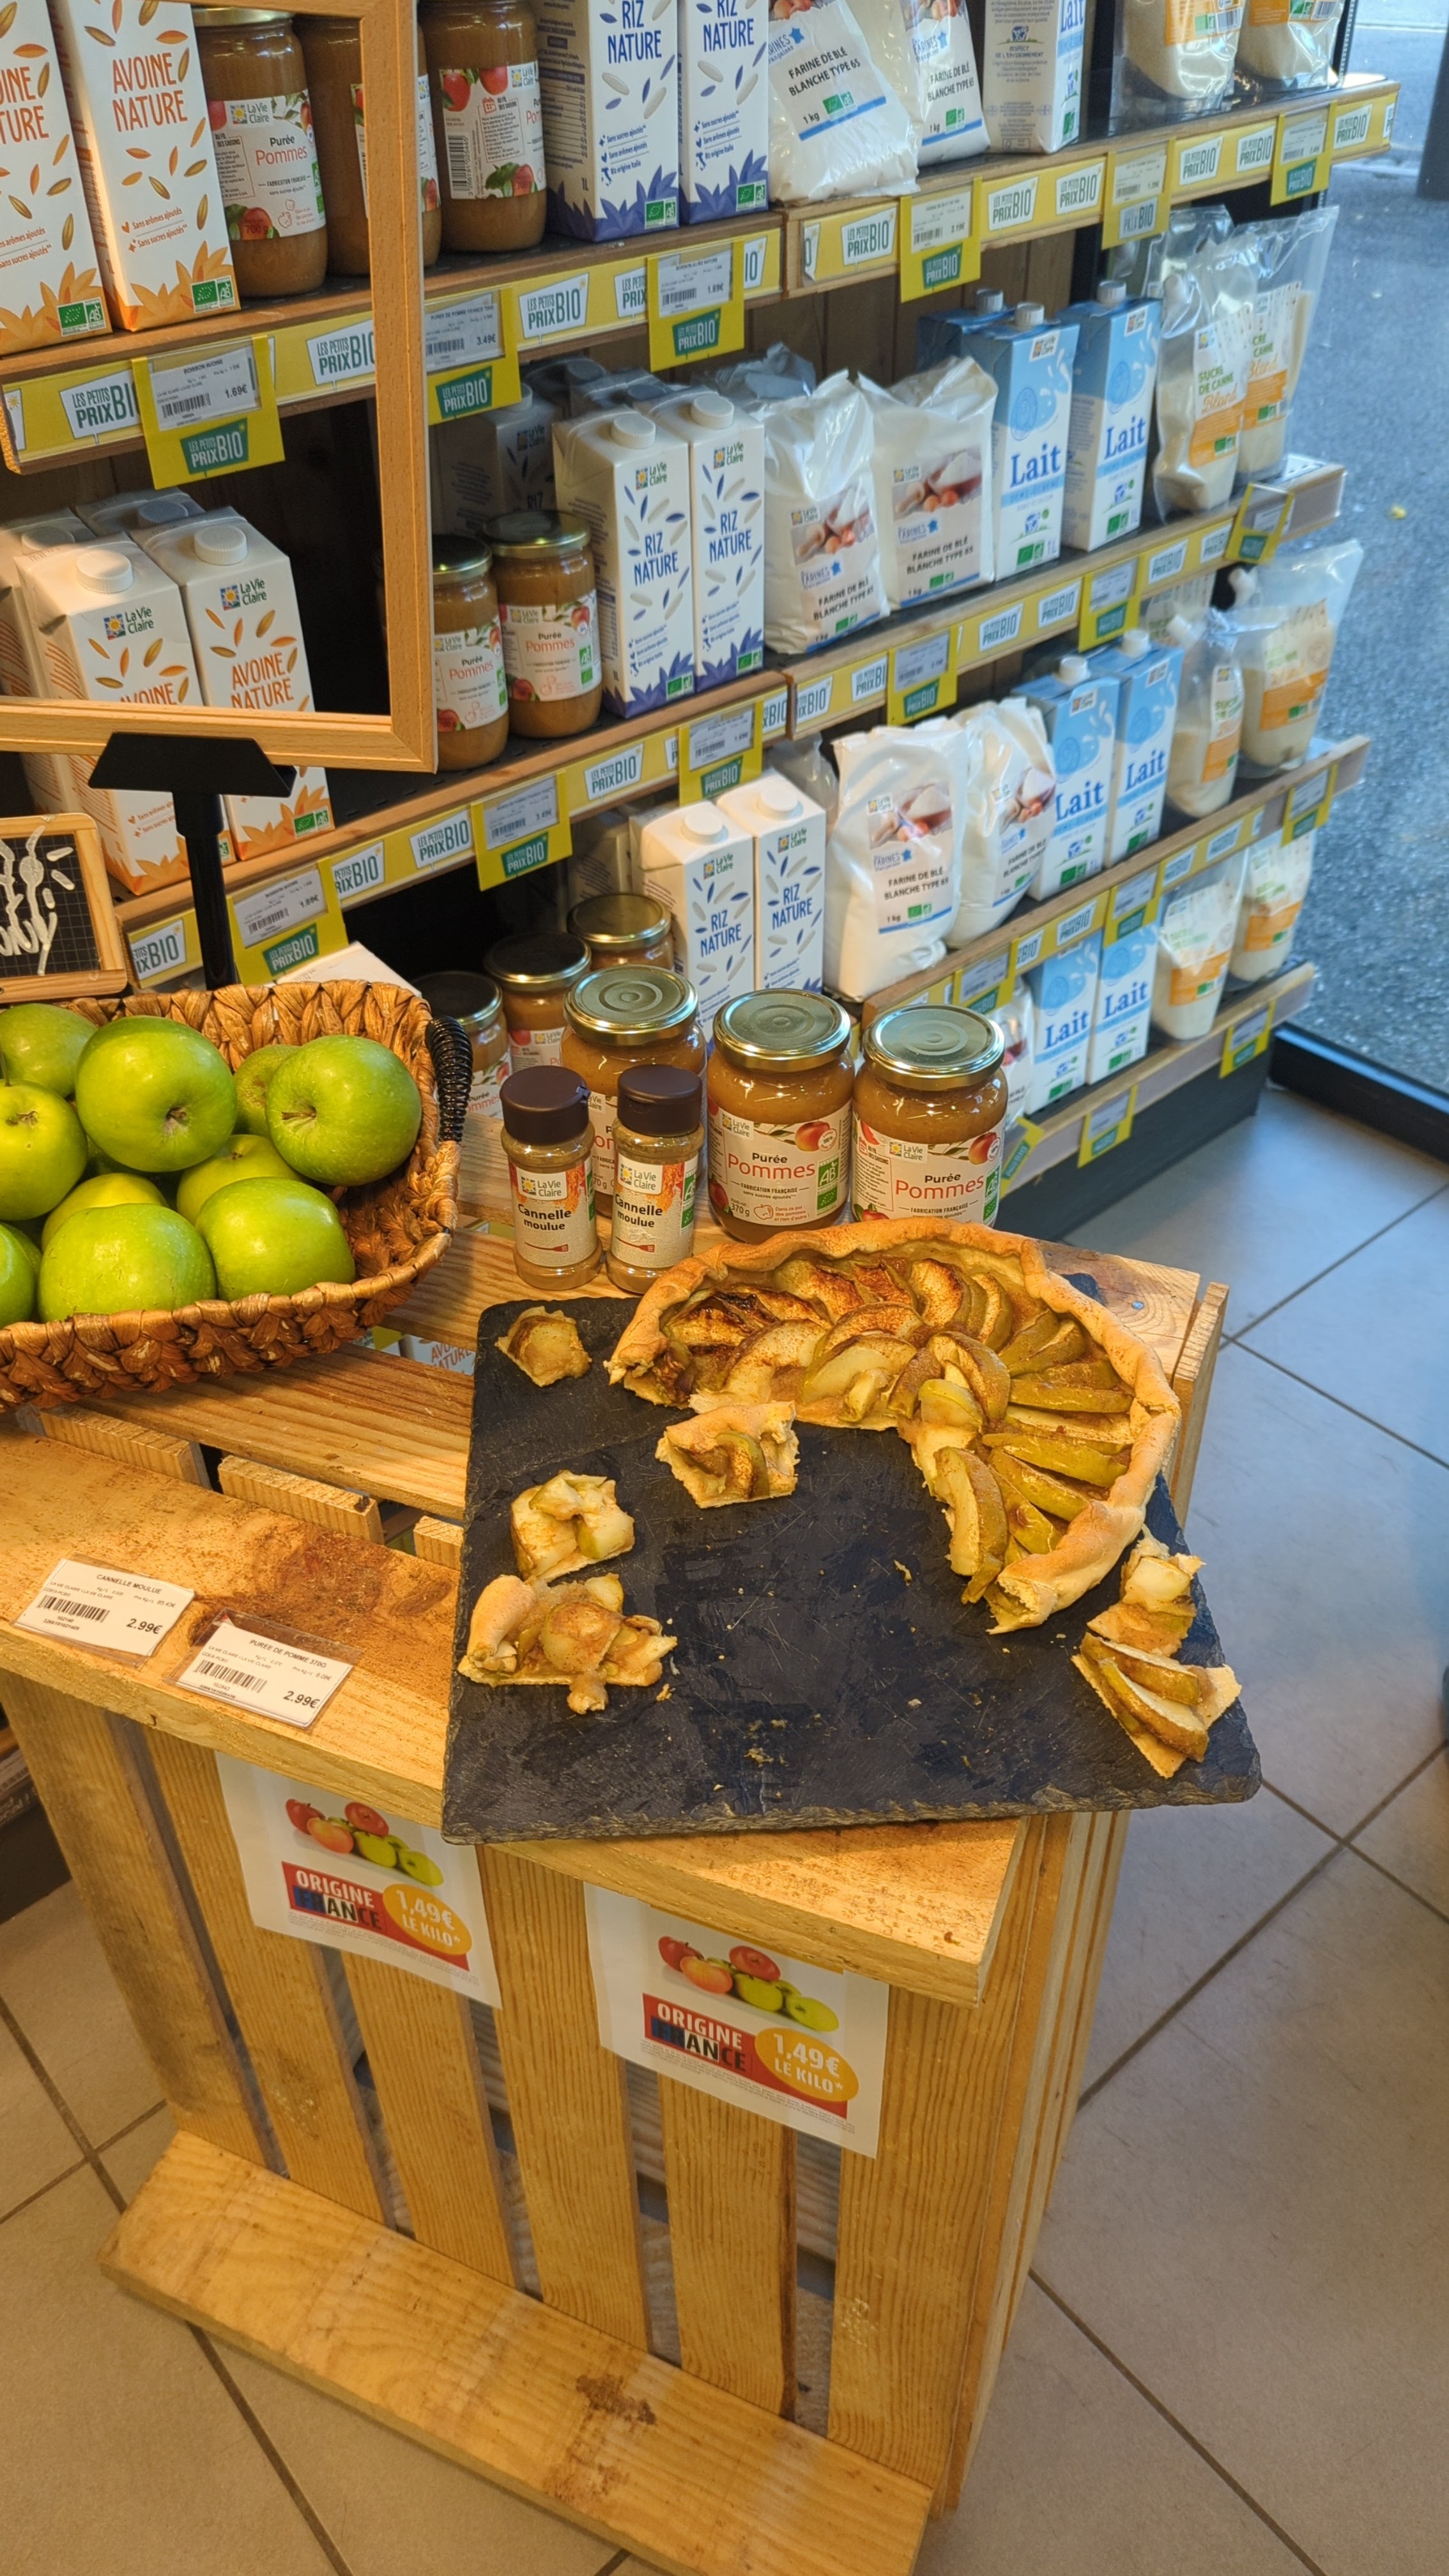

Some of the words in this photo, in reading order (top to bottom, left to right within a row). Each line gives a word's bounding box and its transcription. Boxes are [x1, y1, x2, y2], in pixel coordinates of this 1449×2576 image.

[622, 0, 645, 29] RIZ
[608, 30, 663, 64] NATURE
[703, 19, 755, 52] NATURE
[112, 52, 177, 94] AVOINE
[789, 54, 821, 79] FARINE
[821, 52, 832, 64] DE
[832, 46, 848, 62] BLÉ
[930, 68, 953, 84] FARINE
[953, 66, 961, 79] DE
[961, 61, 970, 76] BLÉ
[789, 72, 831, 96] BLANCHE
[829, 63, 850, 78] TYPE
[850, 59, 861, 69] 65
[927, 85, 955, 102] BLANCHE
[955, 80, 969, 93] TYPE
[112, 90, 188, 132] NATURE
[249, 113, 270, 123] Claire
[803, 116, 808, 124] 1
[809, 112, 820, 124] kg
[933, 123, 940, 133] kg
[270, 135, 295, 147] Purée
[256, 146, 308, 166] Pommes
[1078, 174, 1098, 203] BIO
[1013, 189, 1032, 218] BIO
[869, 220, 889, 252] BIO
[847, 238, 869, 258] PRIX
[942, 253, 959, 280] BIO
[707, 283, 723, 294] 1.69€
[556, 288, 581, 324] BIO
[528, 309, 556, 330] PRIX
[476, 334, 496, 346] 3.49€
[697, 321, 716, 346] BIO
[318, 342, 329, 355] LES
[330, 338, 349, 352] PETITS
[319, 353, 351, 376] PRIX
[72, 392, 86, 408] LES
[87, 389, 111, 405] PETITS
[225, 385, 248, 399] 1.69€
[465, 379, 488, 406] BIO
[1199, 383, 1209, 395] DE
[75, 401, 114, 429] PRIX
[216, 431, 244, 462] BIO
[1105, 416, 1146, 460] Lait
[191, 447, 217, 467] PRIX
[1010, 444, 1061, 488] Lait
[720, 510, 738, 535] RIZ
[645, 532, 663, 556] RIZ
[709, 530, 752, 564] NATURE
[912, 547, 941, 561] FARINE
[942, 542, 953, 553] DE
[954, 537, 968, 549] BLÉ
[634, 551, 679, 586] NATURE
[907, 555, 943, 574] BLANCHE
[944, 550, 963, 563] TYPE
[240, 582, 251, 594] La
[251, 578, 265, 591] Vie
[818, 589, 846, 606] FARINE
[847, 584, 857, 595] DE
[857, 576, 869, 592] BLÉ
[242, 590, 267, 606] Claire
[813, 602, 848, 621] BLANCHE
[850, 593, 866, 609] TYPE
[125, 611, 137, 622] La
[137, 607, 152, 620] Vie
[128, 617, 154, 634] Claire
[526, 639, 575, 653] Pommes
[538, 632, 562, 641] Purée
[232, 652, 286, 690] AVOINE
[449, 661, 494, 680] Pommes
[461, 656, 483, 666] Purée
[807, 687, 826, 716] BIO
[615, 755, 636, 785] BIO
[1125, 751, 1165, 792] Lait
[592, 776, 615, 793] PRIX
[1056, 781, 1104, 822] Lait
[446, 820, 470, 850] BIO
[419, 841, 445, 861] PRIX
[526, 842, 545, 868] BIO
[352, 856, 379, 886] BIO
[889, 873, 916, 887] FARINE
[918, 871, 928, 880] DE
[930, 866, 944, 878] BLÉ
[783, 884, 800, 905] RIZ
[884, 885, 920, 900] BLANCHE
[922, 880, 940, 892] TYPE
[940, 877, 949, 886] 65
[299, 894, 319, 908] 1.69€
[711, 910, 728, 932] RIZ
[772, 898, 813, 930] NATURE
[147, 935, 180, 969] BIO
[294, 934, 316, 960] BIO
[700, 924, 741, 958] NATURE
[1103, 982, 1147, 1019] Lait
[1045, 1012, 1089, 1050] Lait
[733, 1126, 750, 1138] Claire
[752, 1153, 788, 1163] Purée
[903, 1144, 911, 1152] La
[912, 1146, 923, 1154] Vie
[903, 1152, 923, 1161] Claire
[634, 1170, 644, 1178] La
[643, 1171, 657, 1181] Vie
[728, 1153, 815, 1180] Pommes
[820, 1167, 836, 1186] AB
[924, 1173, 961, 1183] Purée
[548, 1180, 561, 1188] Vie
[633, 1180, 656, 1190] Claire
[740, 1183, 770, 1193] FABRICATION
[896, 1175, 984, 1199] Pommes
[518, 1203, 572, 1220] Cannelle
[615, 1193, 663, 1216] Cannelle
[731, 1204, 744, 1214] 370
[746, 1208, 751, 1217] g
[944, 1203, 969, 1213] FRANÇAISE
[524, 1218, 566, 1231] moulue
[617, 1210, 655, 1228] moulue
[96, 1574, 132, 1588] CANNELLE
[133, 1583, 162, 1595] MOULUE
[126, 1618, 163, 1634] 2.99€
[249, 1639, 273, 1651] PUREE
[283, 1650, 309, 1662] POMME
[310, 1659, 327, 1668] 370G
[283, 1690, 321, 1708] 2.99€
[296, 1869, 375, 1909] ORIGINE
[297, 1886, 383, 1931] FRANCE
[397, 1890, 455, 1931] 1,49€
[402, 1913, 418, 1934] LE
[657, 2002, 742, 2050] ORIGINE
[653, 2019, 746, 2072] FRANCE
[774, 2033, 839, 2078] 1,49€
[775, 2058, 791, 2075] LE
